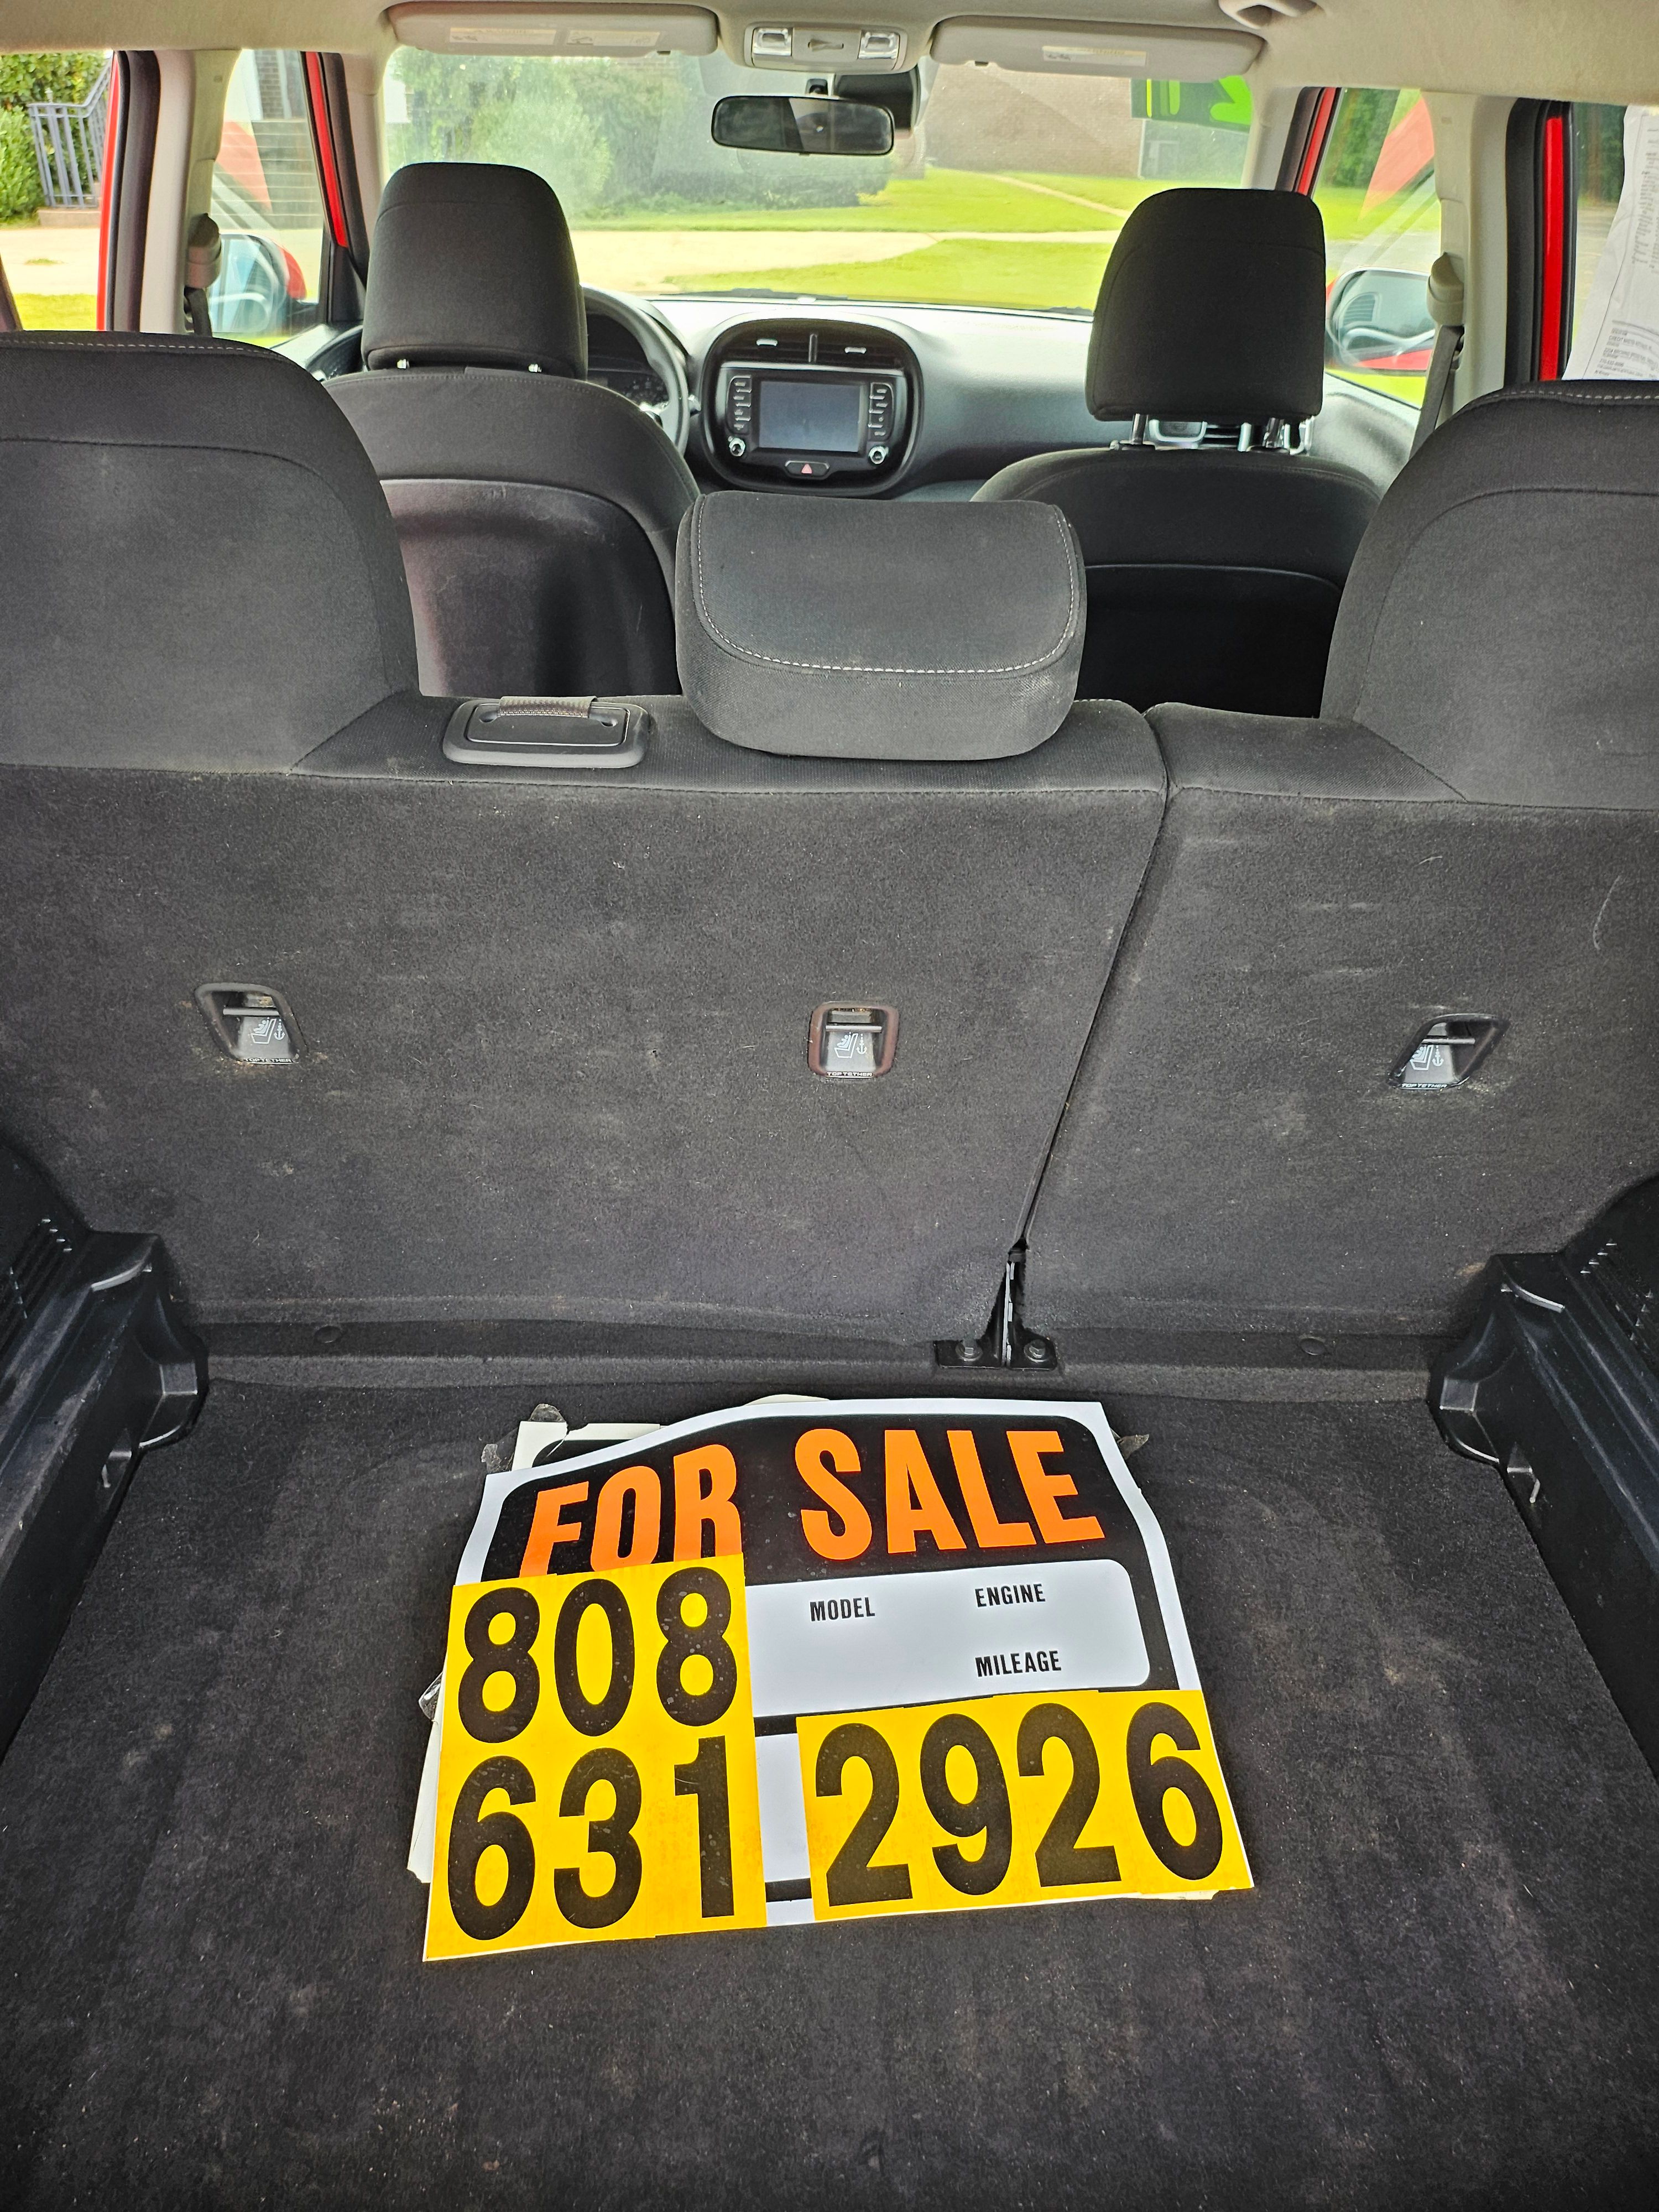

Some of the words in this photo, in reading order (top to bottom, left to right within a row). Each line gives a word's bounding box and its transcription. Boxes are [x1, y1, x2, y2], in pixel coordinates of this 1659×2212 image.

[519, 1444, 743, 1579] FOR
[795, 1428, 1105, 1561] SALE
[457, 1566, 738, 1744] 808
[810, 1597, 875, 1622] MODEL
[974, 1583, 1046, 1608] ENGINE
[975, 1650, 1062, 1677] MILEAGE
[447, 1735, 735, 1940] 631
[815, 1702, 1223, 1906] 2926
